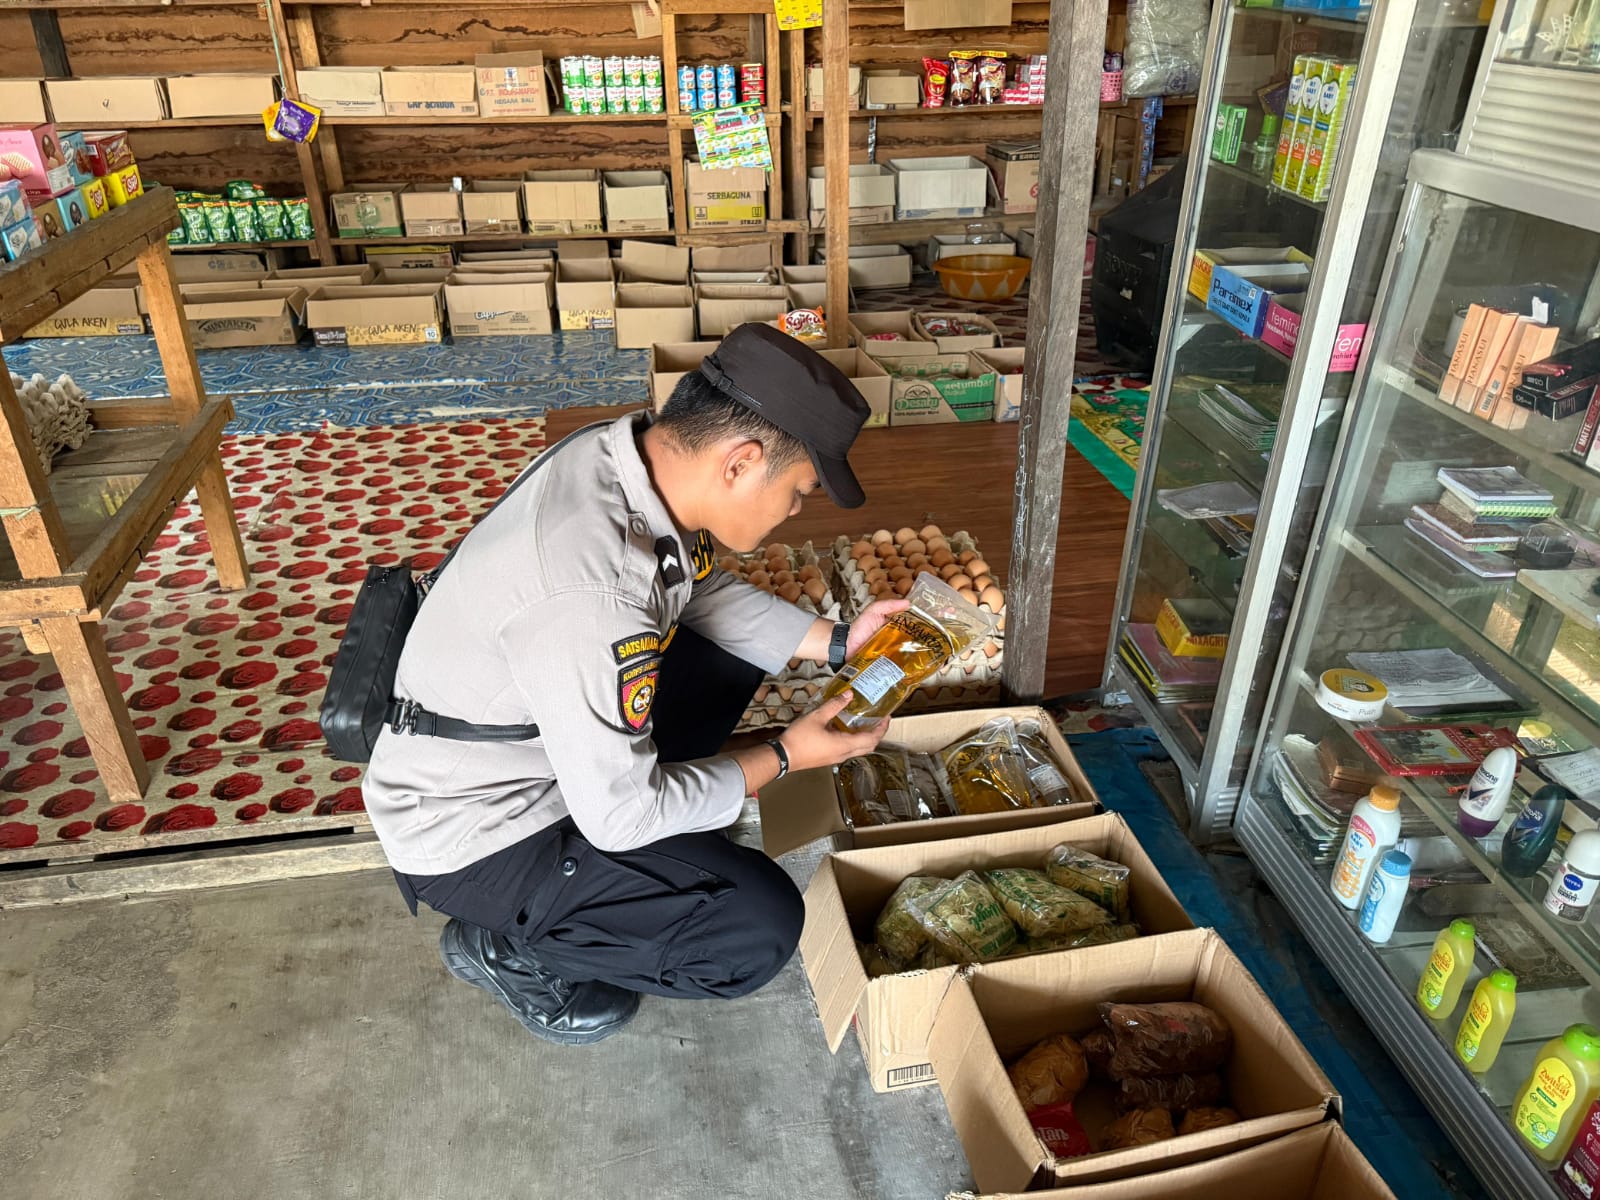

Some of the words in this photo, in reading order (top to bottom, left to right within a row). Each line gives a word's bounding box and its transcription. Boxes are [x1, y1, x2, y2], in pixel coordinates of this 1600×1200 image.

[1306, 87, 1316, 95] BABY
[707, 192, 751, 200] SERBAGUNA
[1213, 277, 1253, 313] Paramex
[786, 313, 821, 330] Sajiku
[427, 331, 437, 339] 10
[1448, 332, 1469, 377] HANASUI
[1467, 339, 1488, 384] HANASUI
[1578, 421, 1594, 447] MATTE
[1565, 876, 1581, 888] NIVEA
[1540, 1067, 1569, 1098] Zwitsal
